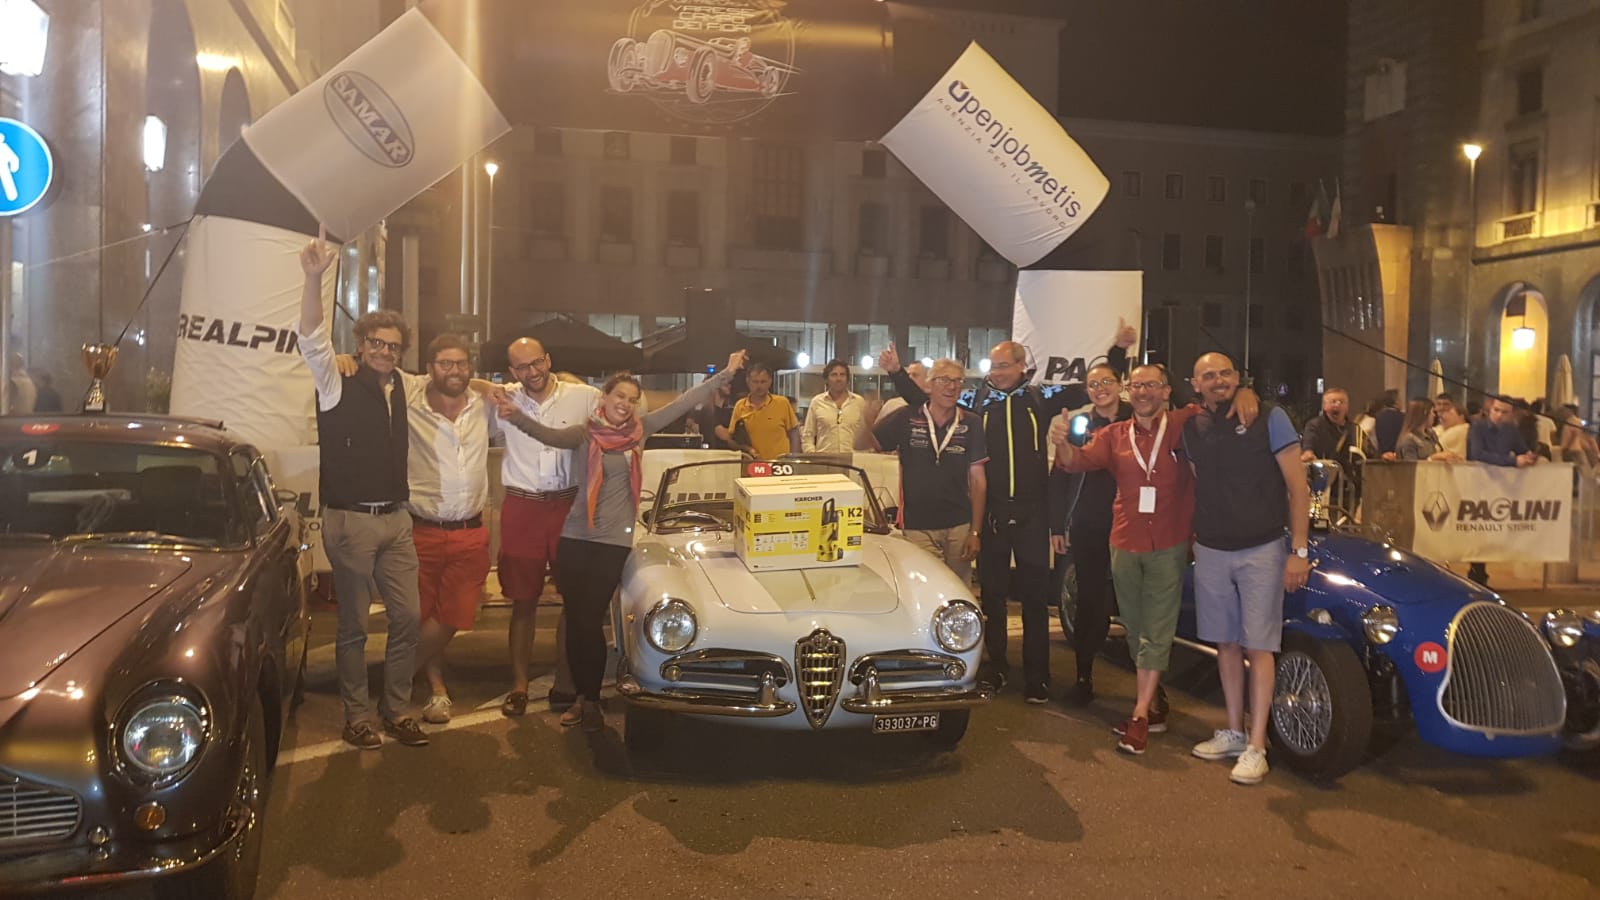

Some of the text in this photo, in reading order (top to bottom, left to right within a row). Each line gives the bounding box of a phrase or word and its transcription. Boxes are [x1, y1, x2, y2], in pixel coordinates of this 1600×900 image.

[333, 75, 409, 163] SAMAR
[937, 97, 982, 144] AGENZIA
[987, 148, 1007, 169] PER
[22, 449, 38, 466] 1
[753, 464, 793, 475] M 30
[1456, 497, 1563, 522] PAGLINI
[1455, 523, 1504, 532] RENAULT
[1423, 650, 1438, 665] M
[877, 715, 937, 730] 393037 PG
